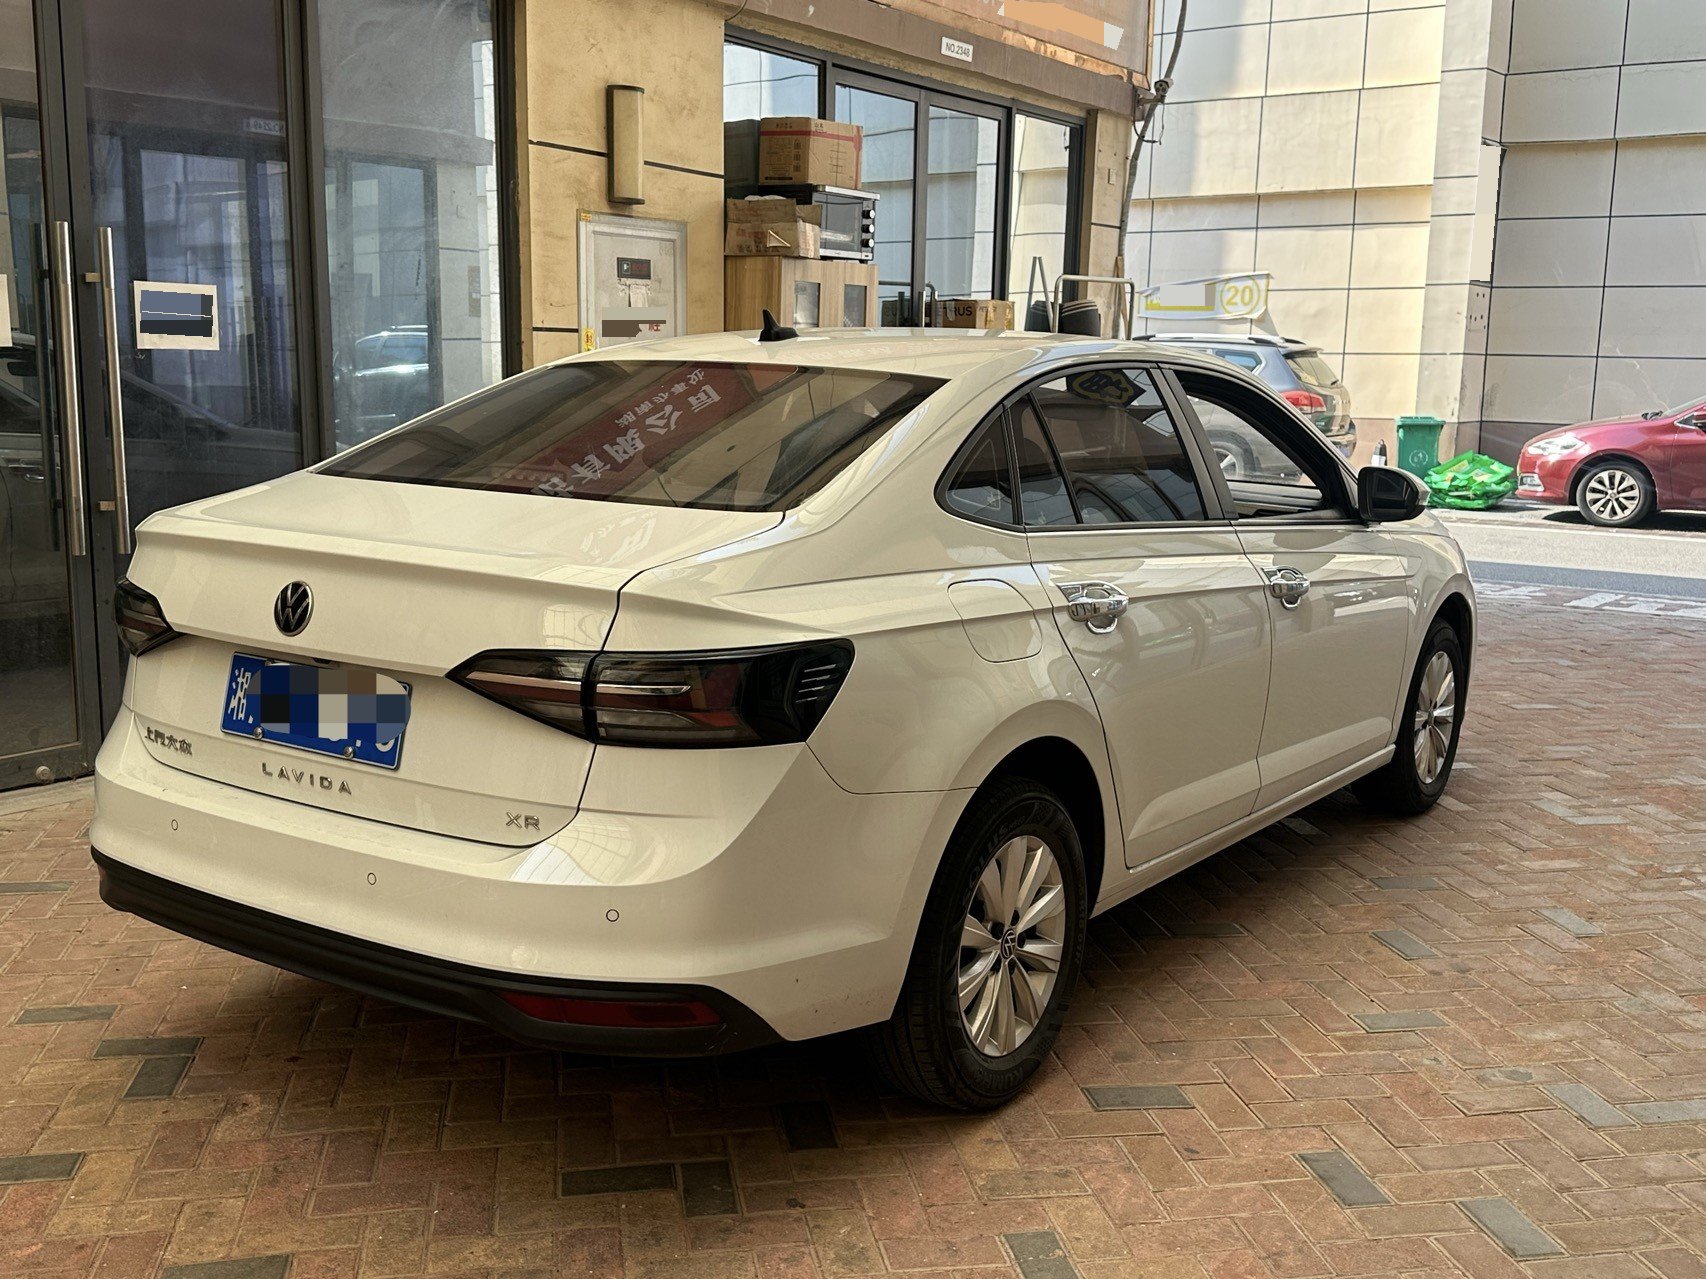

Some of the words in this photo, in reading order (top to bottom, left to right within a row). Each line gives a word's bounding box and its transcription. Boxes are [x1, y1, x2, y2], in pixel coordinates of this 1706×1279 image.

[945, 42, 971, 57] NO.2348
[1225, 285, 1254, 306] 20
[144, 726, 193, 757] 上汽大众
[261, 762, 352, 796] LAVIDA
[506, 811, 541, 831] XR
